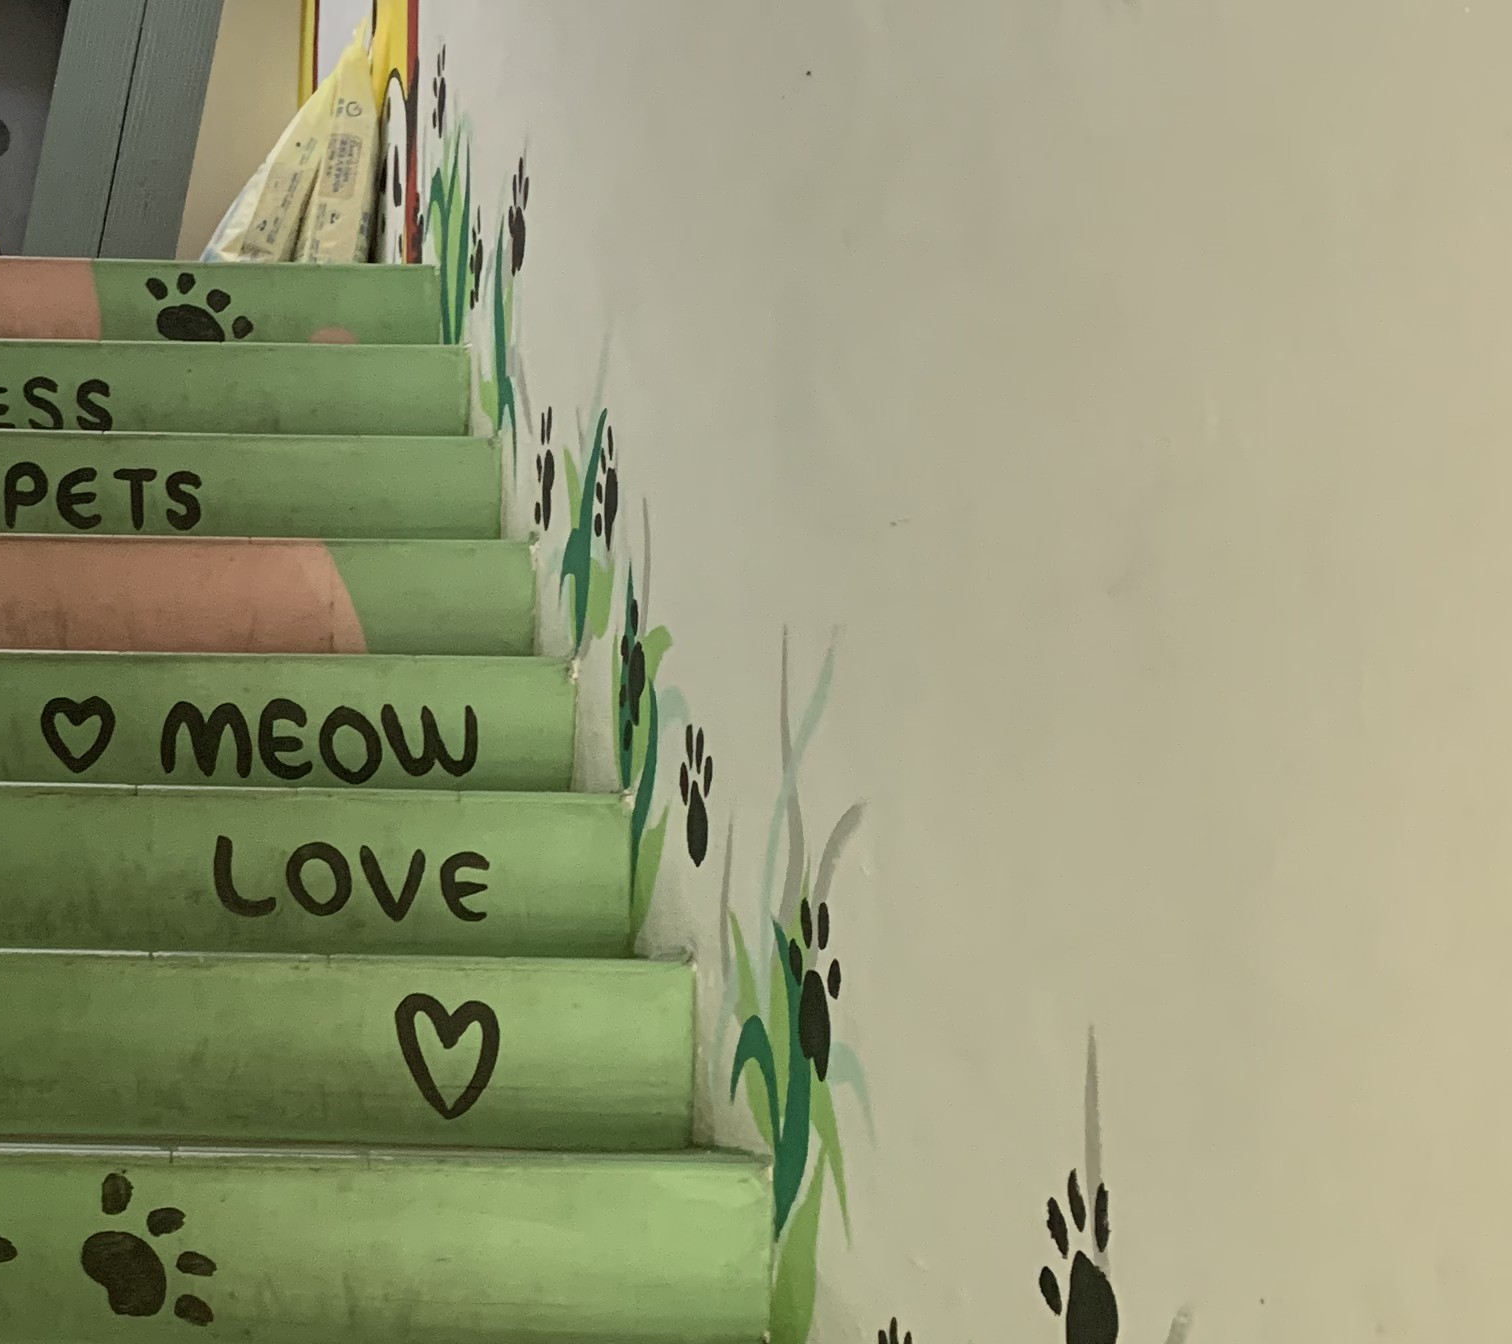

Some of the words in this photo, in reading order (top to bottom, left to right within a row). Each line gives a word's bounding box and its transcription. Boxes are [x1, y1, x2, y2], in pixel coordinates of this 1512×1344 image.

[3, 461, 203, 532] PETS
[159, 698, 478, 784] MEOW
[213, 835, 490, 923] LOVE
